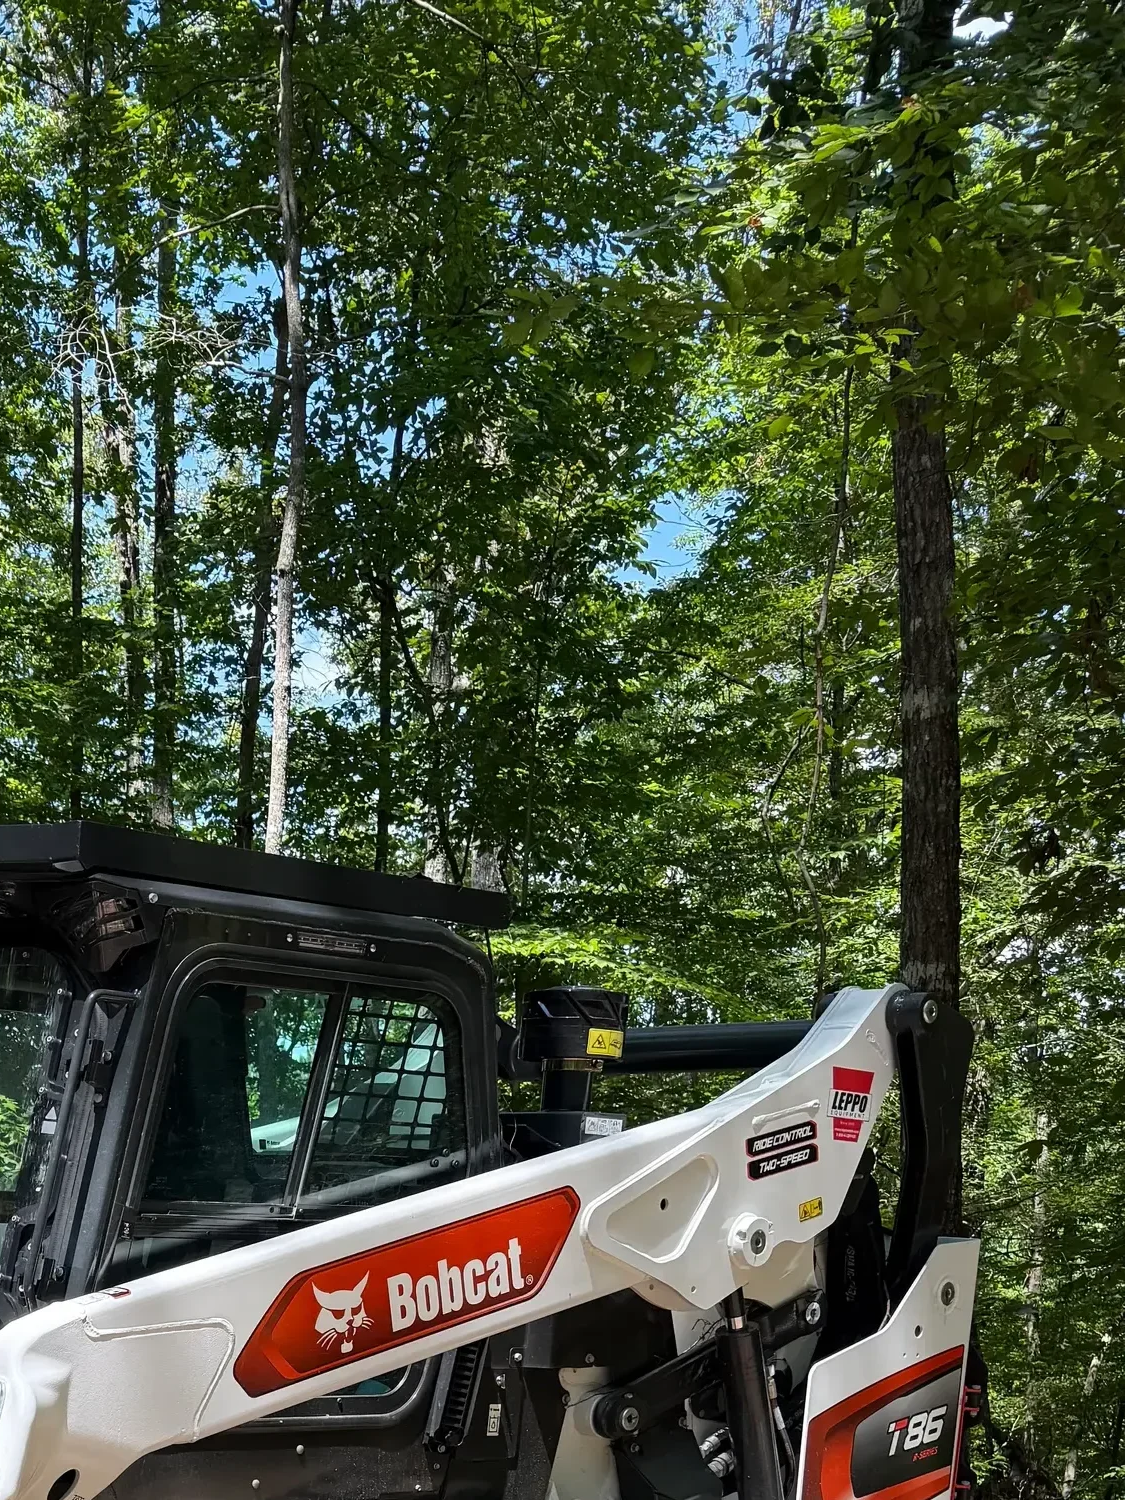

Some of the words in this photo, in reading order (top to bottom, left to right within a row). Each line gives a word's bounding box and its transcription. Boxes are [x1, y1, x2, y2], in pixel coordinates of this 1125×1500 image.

[830, 1109, 865, 1119] EQUIPMENT
[831, 1091, 869, 1113] LEPPO
[759, 1149, 810, 1174] TWO-SPEED
[386, 1237, 525, 1333] Bobcat
[888, 1405, 948, 1457] T86
